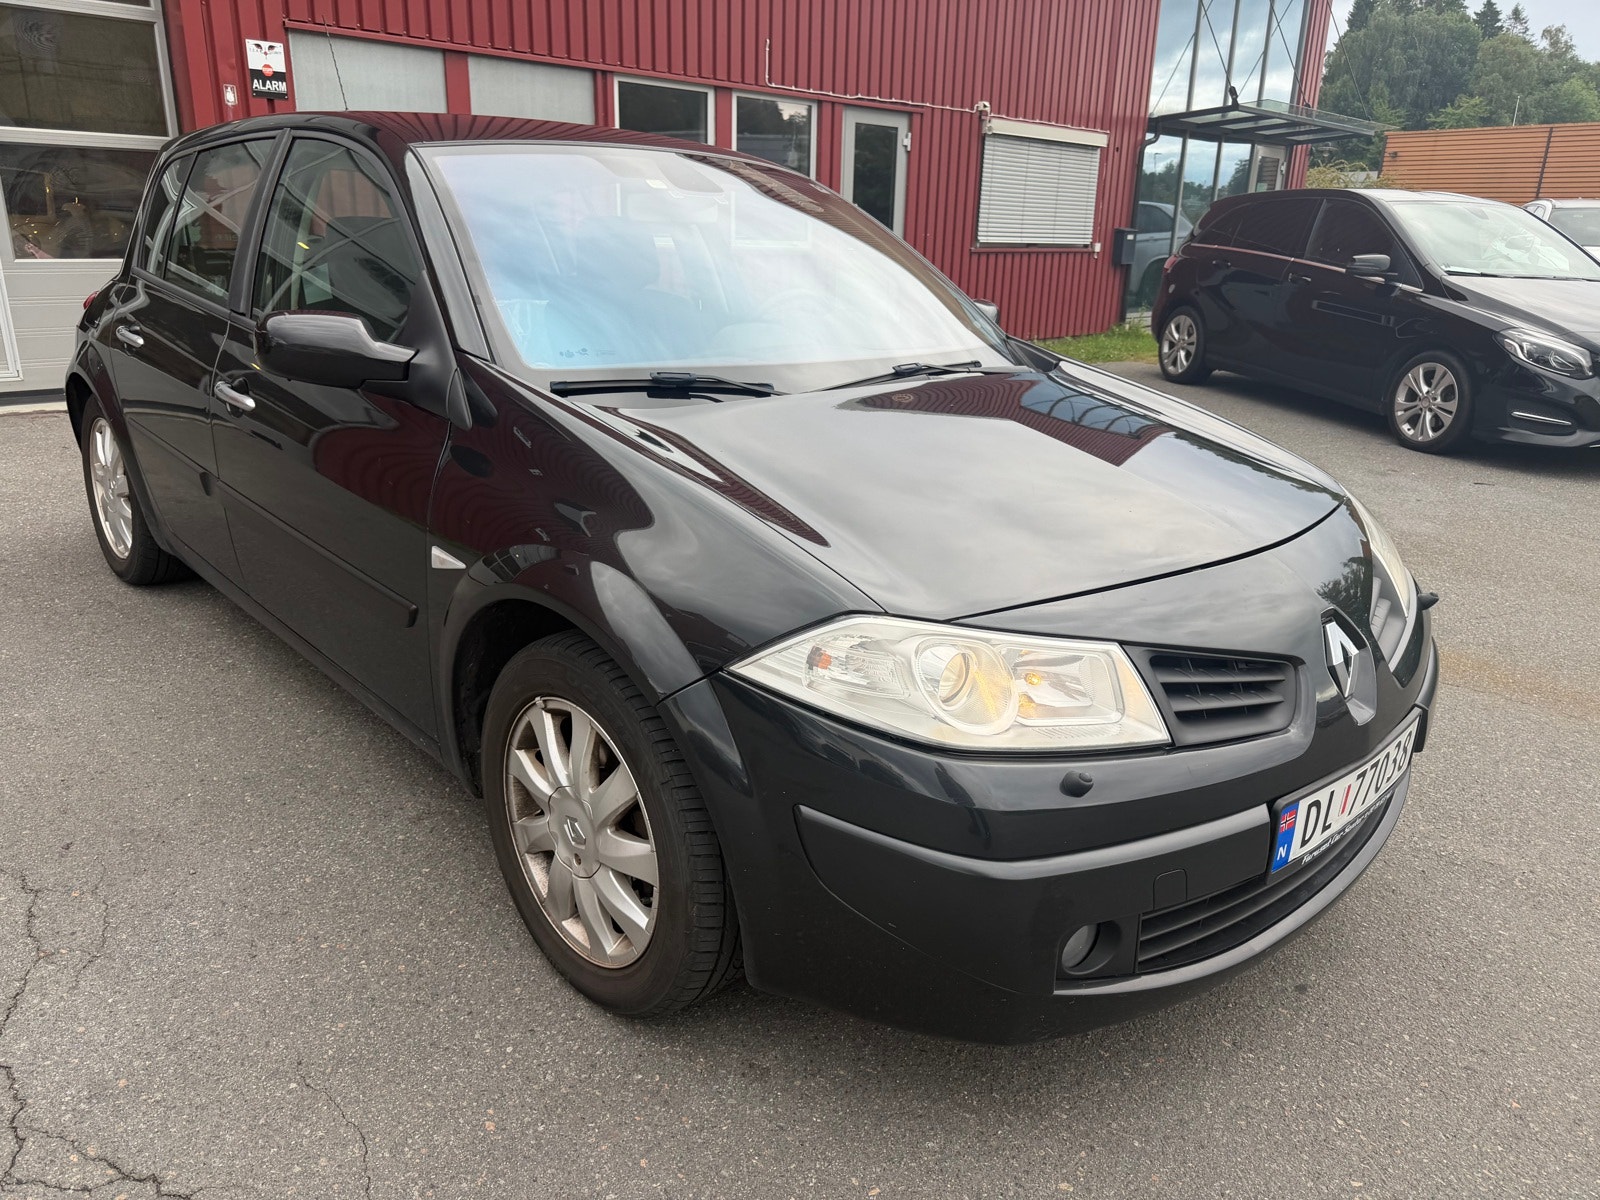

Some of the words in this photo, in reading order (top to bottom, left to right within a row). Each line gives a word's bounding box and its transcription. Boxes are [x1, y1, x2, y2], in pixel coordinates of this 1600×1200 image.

[253, 79, 287, 92] ALARM
[1300, 790, 1335, 849] DL
[1347, 730, 1412, 817] 77038
[1277, 844, 1288, 860] N
